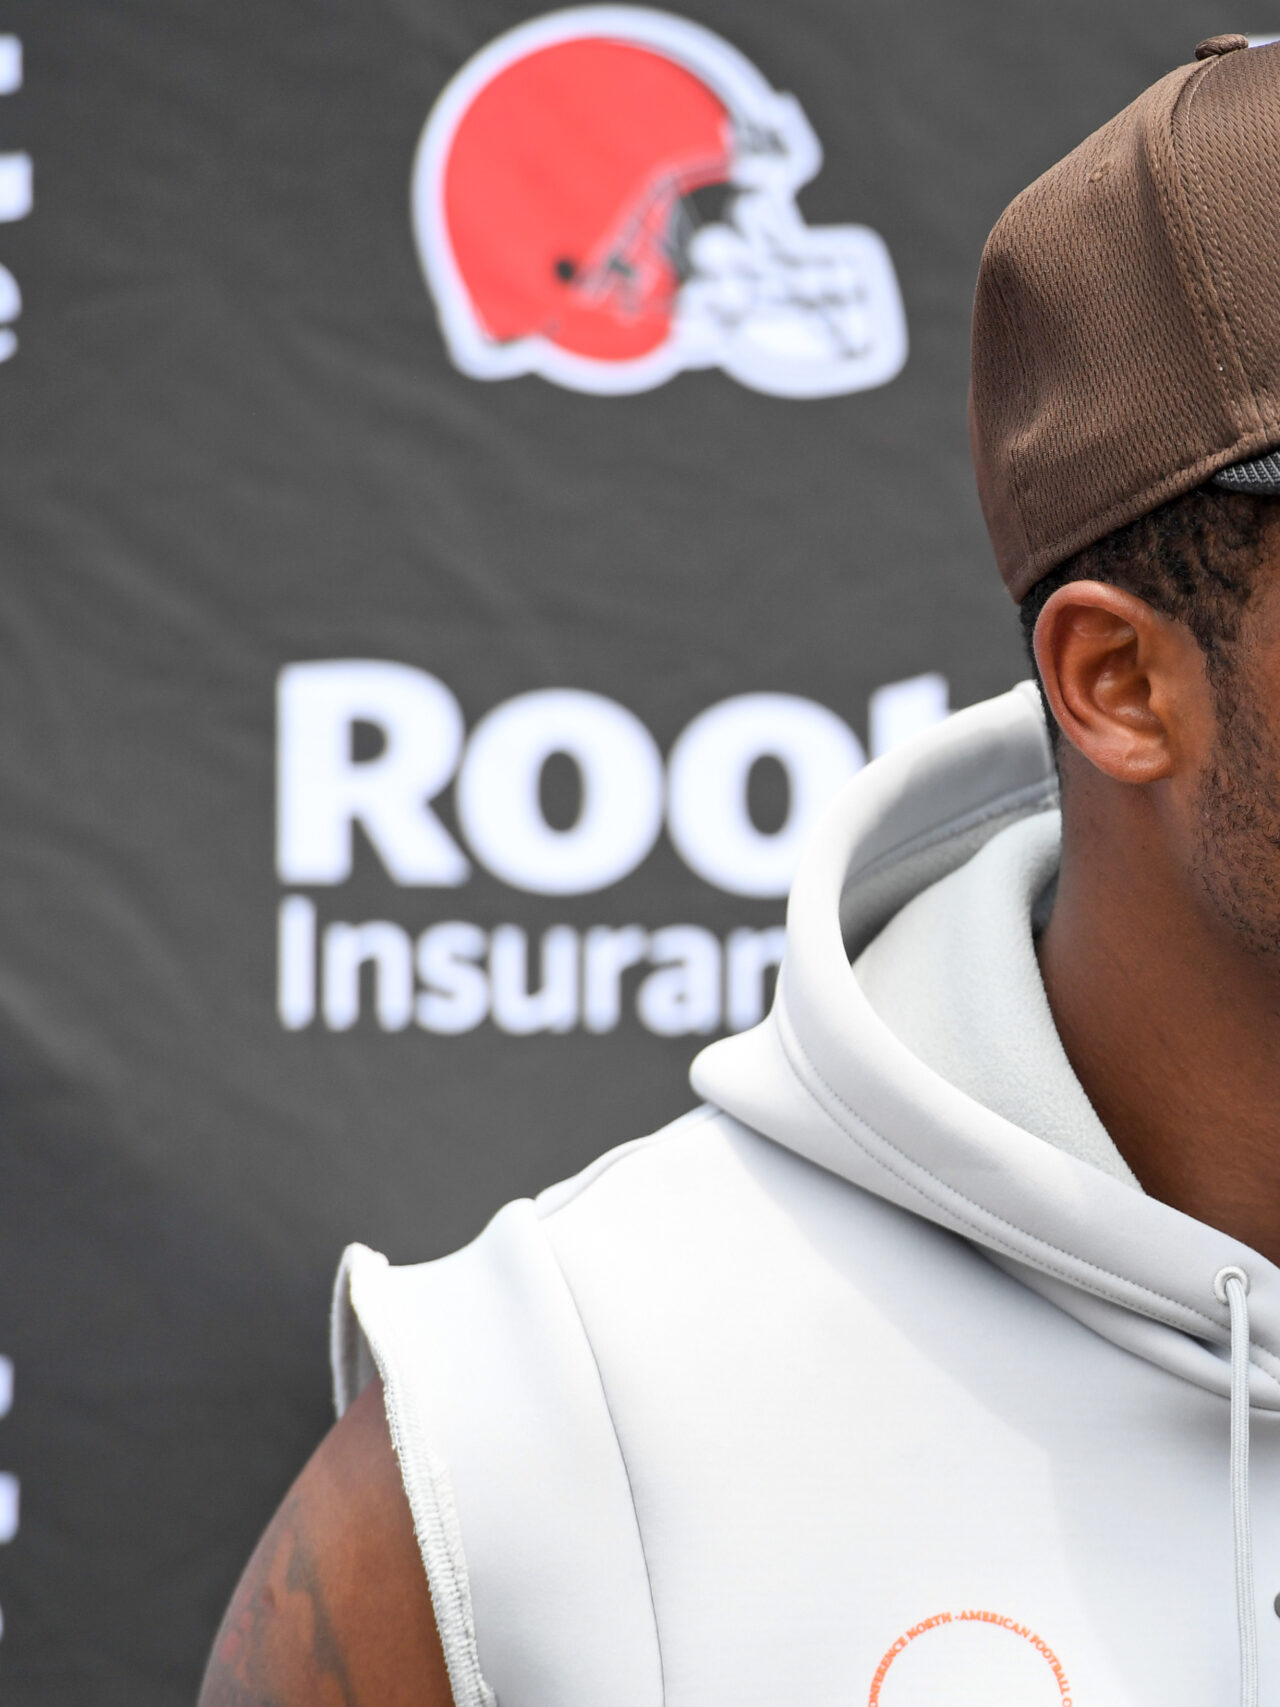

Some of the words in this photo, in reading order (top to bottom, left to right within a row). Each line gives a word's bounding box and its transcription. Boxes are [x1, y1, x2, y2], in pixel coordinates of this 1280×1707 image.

[275, 658, 958, 896] Roo
[868, 1636, 908, 1707] ONFERENCE
[906, 1612, 952, 1641] NORTH
[1029, 1634, 1070, 1696] FOOTBALL
